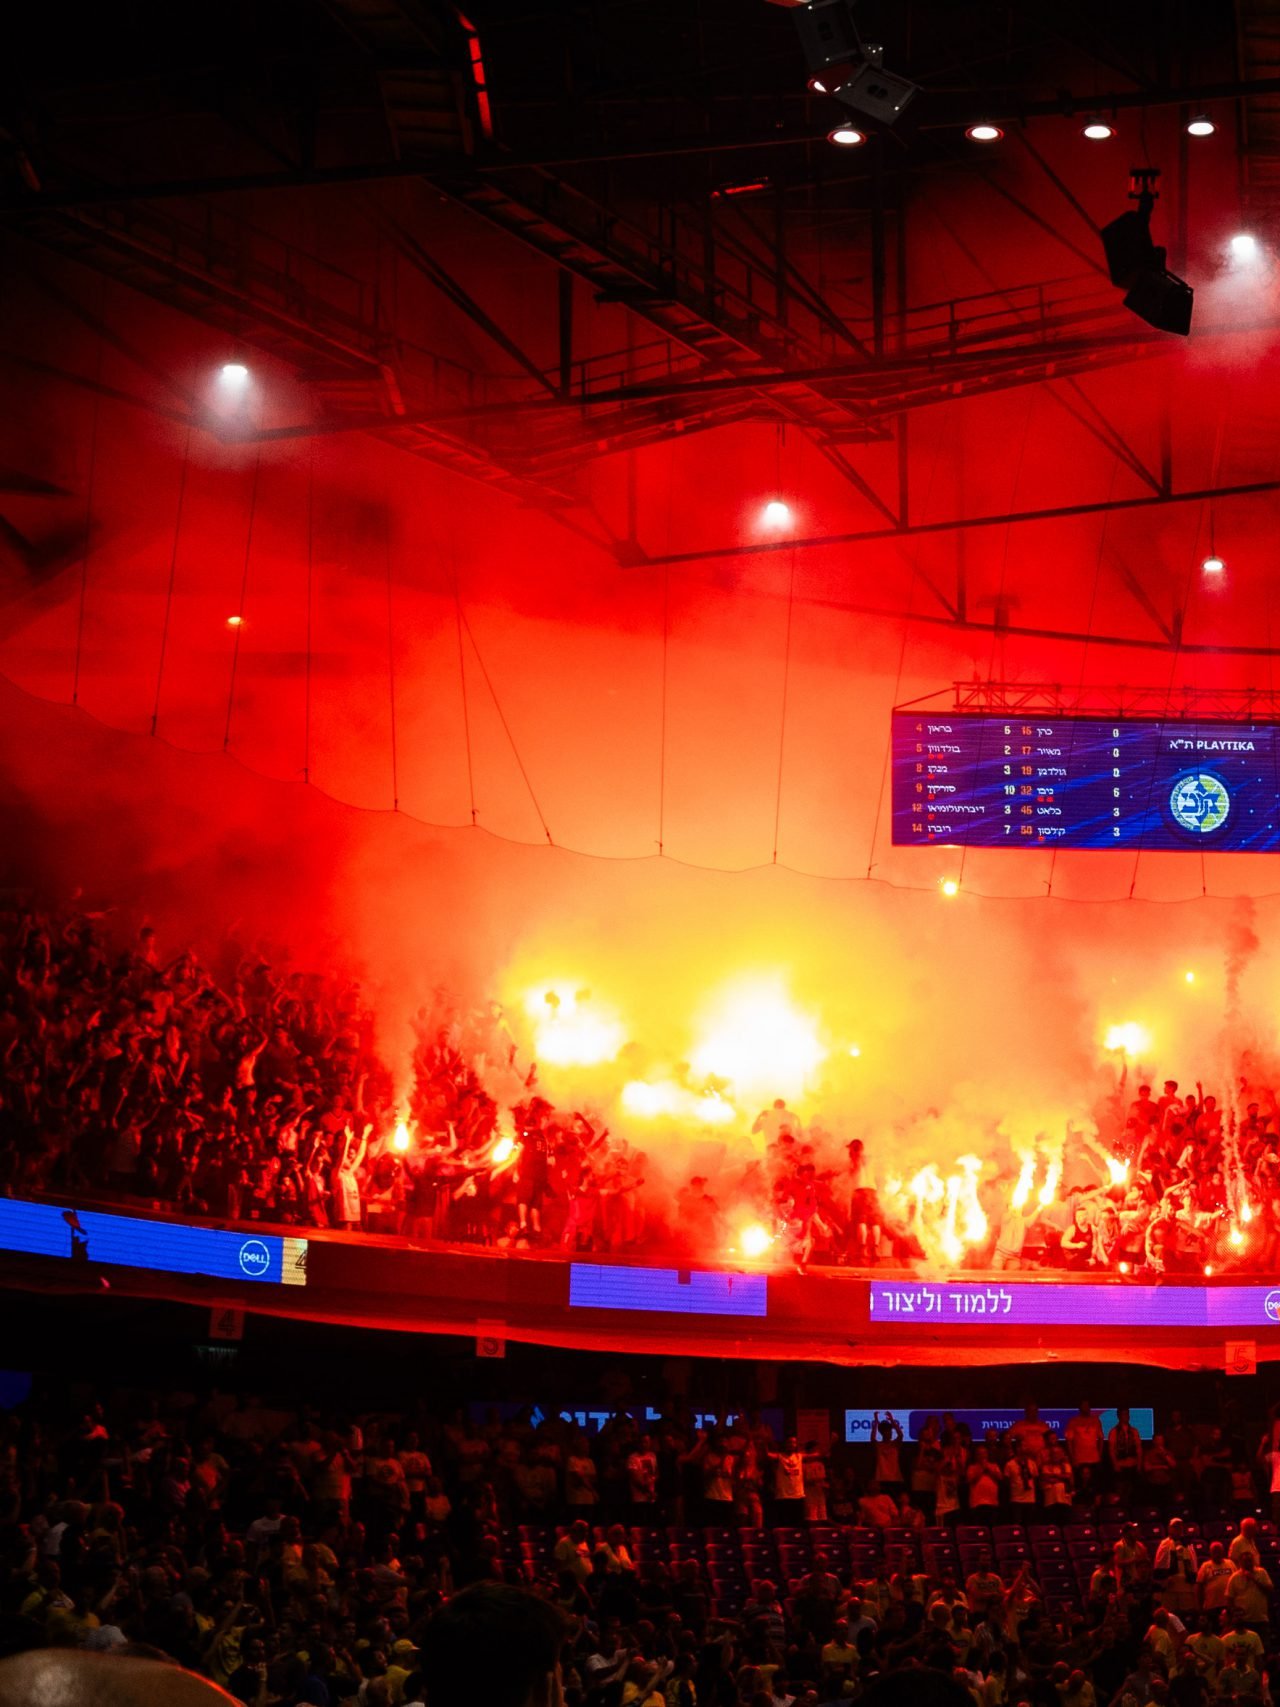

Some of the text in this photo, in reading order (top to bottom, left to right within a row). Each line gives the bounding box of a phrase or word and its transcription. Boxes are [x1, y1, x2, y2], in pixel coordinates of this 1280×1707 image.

[916, 723, 923, 732] 4
[1004, 745, 1011, 755] 2
[1022, 745, 1032, 755] 17
[1197, 741, 1255, 751] PLAYTIKA
[1004, 765, 1011, 775] 3
[1004, 785, 1015, 795] 10
[1004, 804, 1011, 815] 3
[1113, 807, 1120, 817] 3
[912, 823, 923, 833] 14
[1004, 825, 1011, 834] 7
[243, 1252, 267, 1264] DELL
[882, 1287, 941, 1313] וליצור
[949, 1288, 1012, 1314] ללמוד
